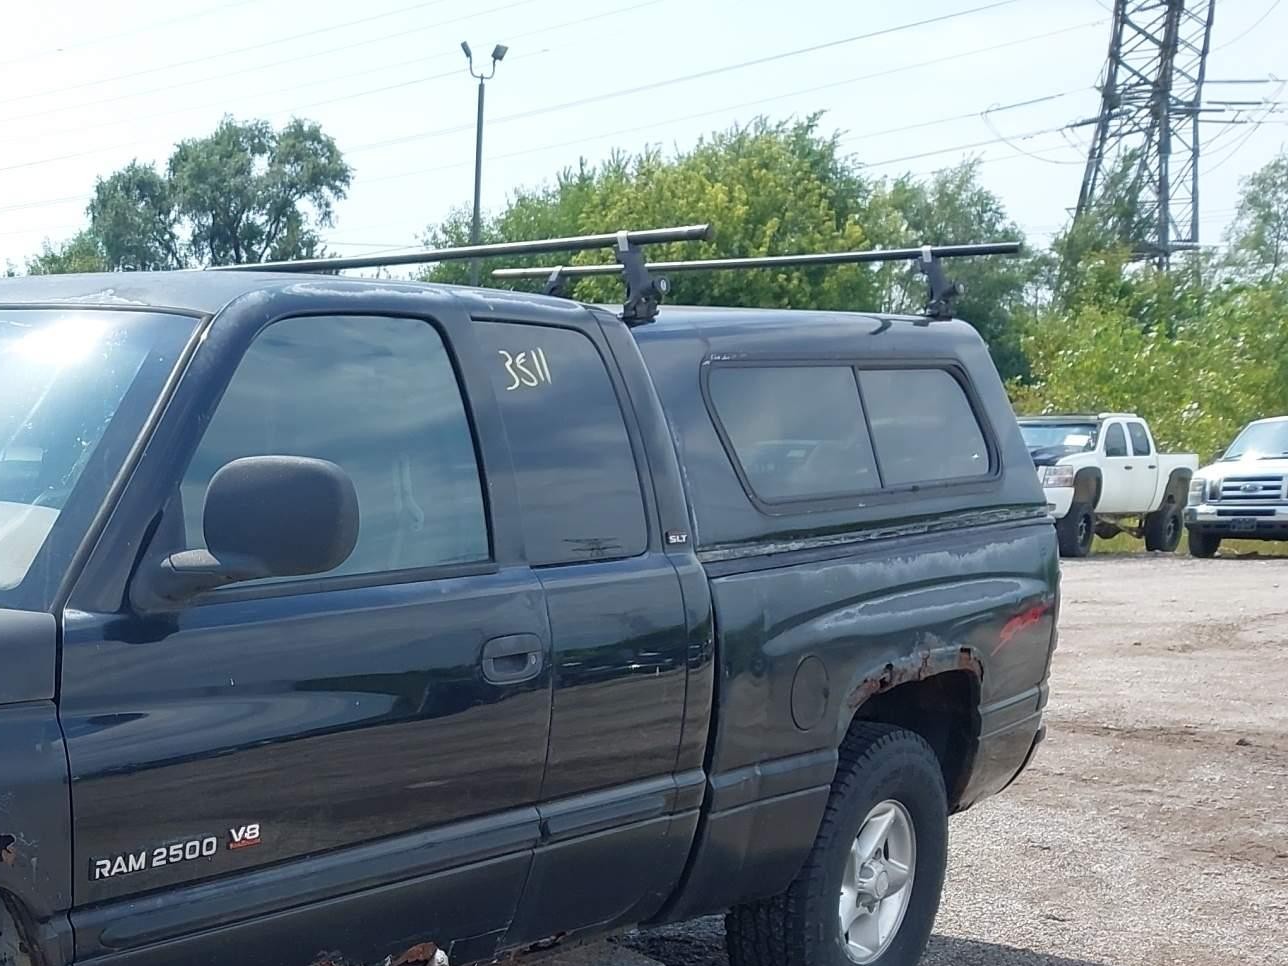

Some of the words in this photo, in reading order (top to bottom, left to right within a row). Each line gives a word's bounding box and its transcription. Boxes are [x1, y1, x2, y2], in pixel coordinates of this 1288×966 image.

[497, 347, 552, 391] 3511
[669, 534, 688, 544] SLT
[95, 851, 146, 879] RAM
[151, 836, 217, 868] 2500
[229, 823, 261, 842] V8
